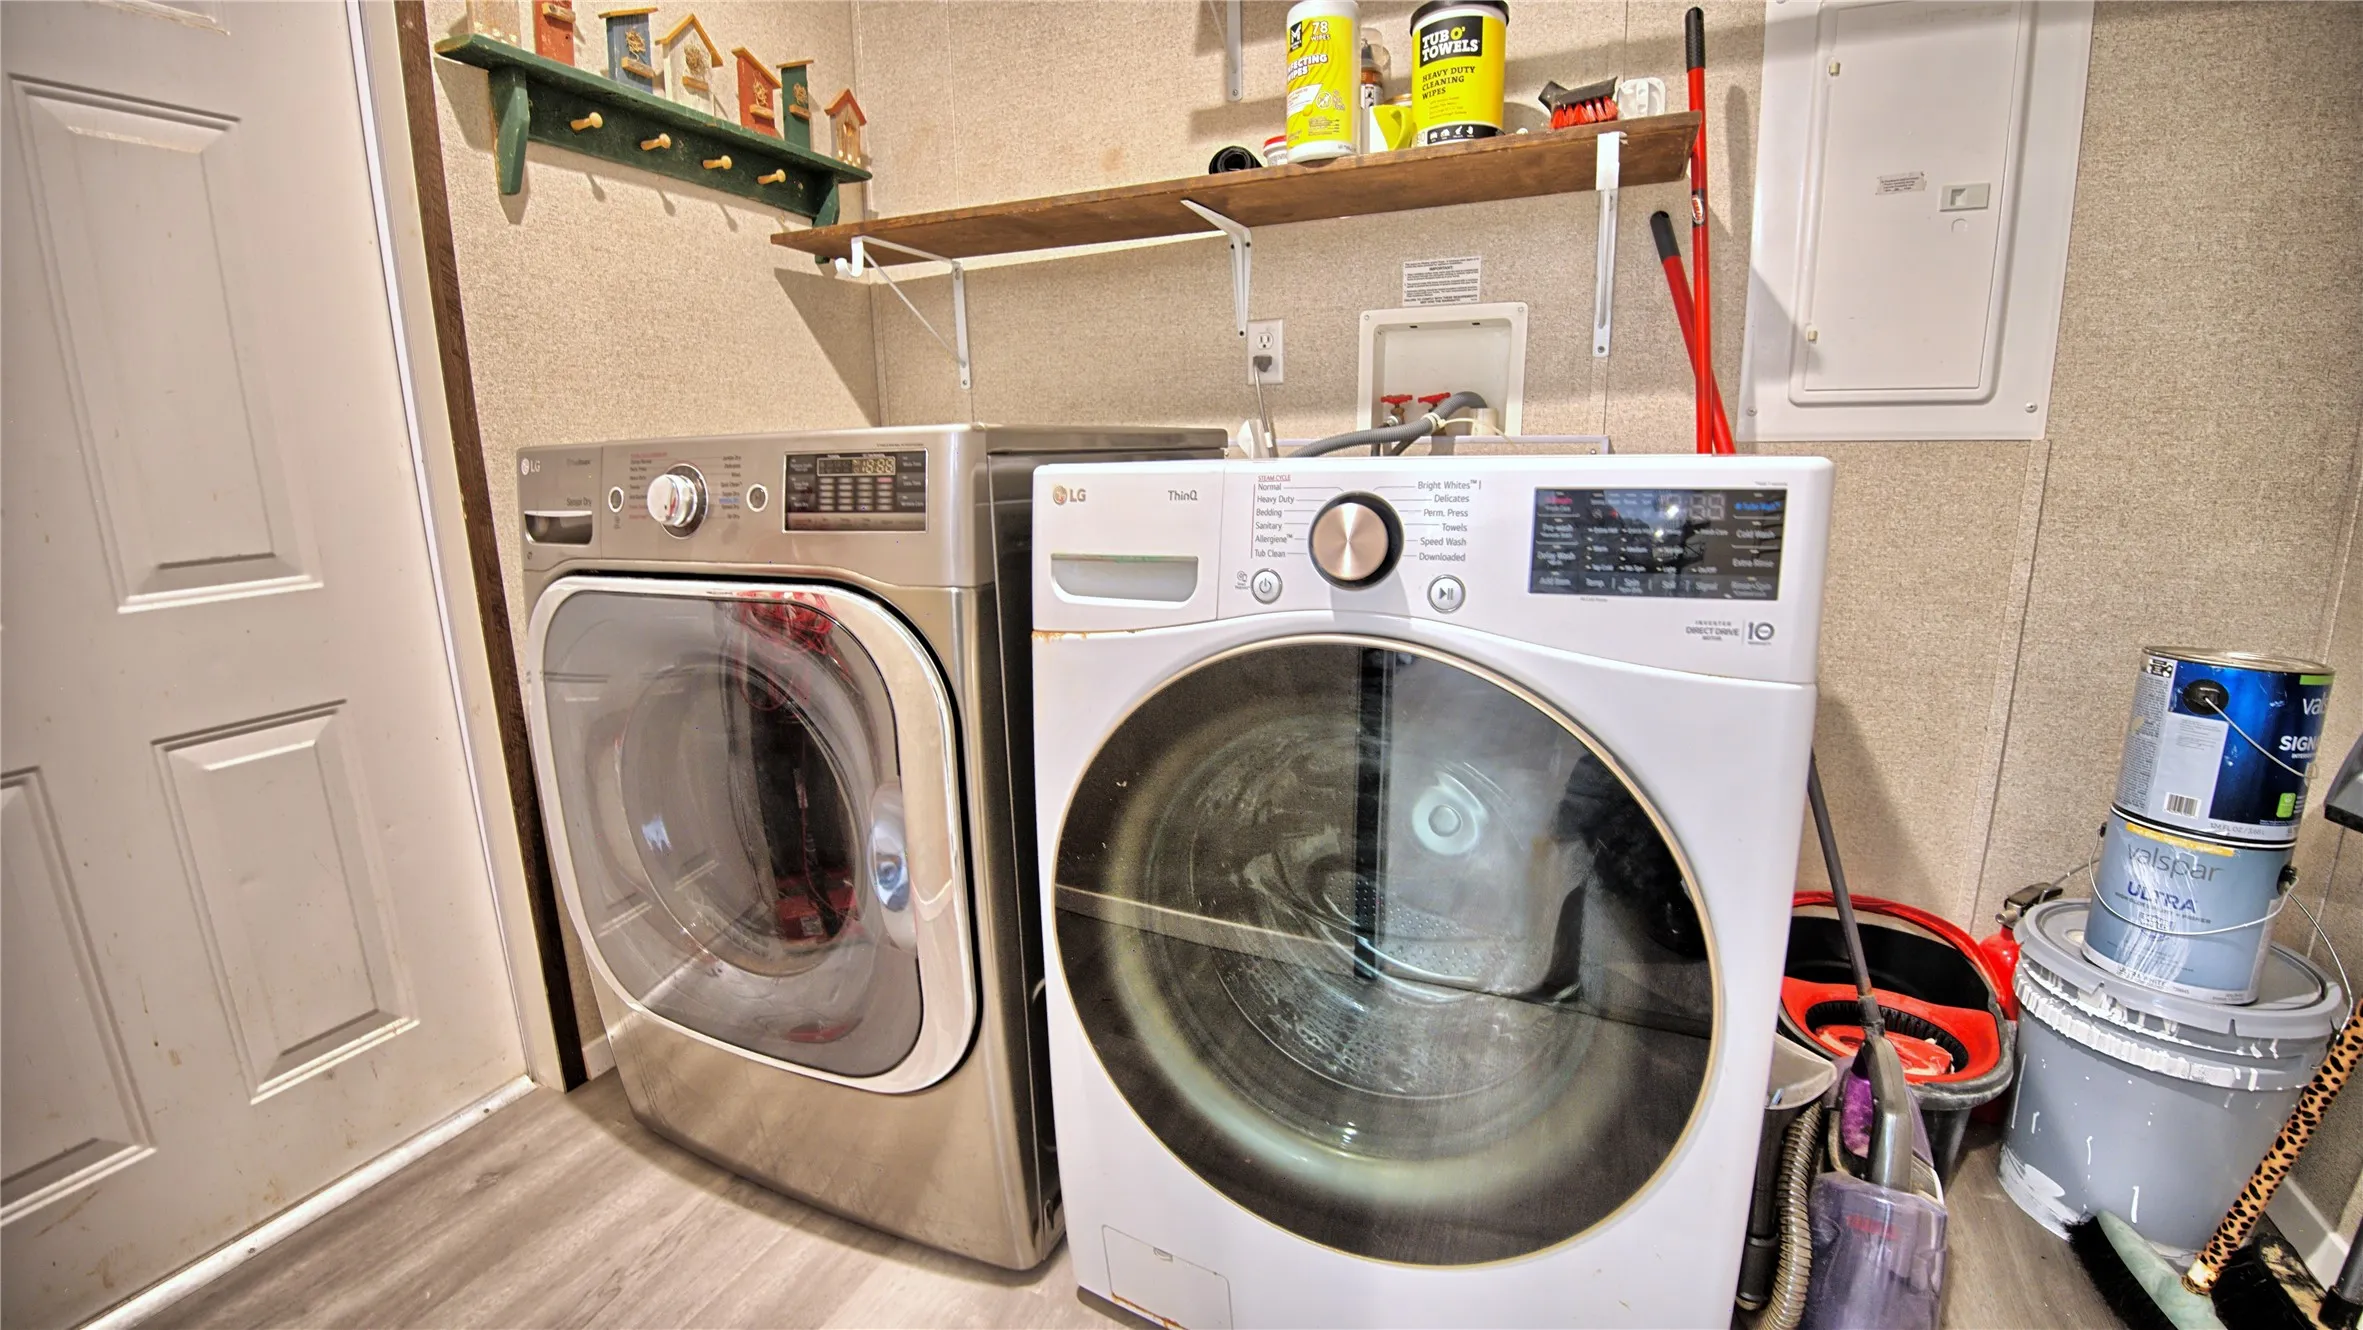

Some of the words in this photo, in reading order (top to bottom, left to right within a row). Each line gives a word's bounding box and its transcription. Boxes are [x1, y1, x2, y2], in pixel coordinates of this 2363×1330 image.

[1312, 21, 1328, 35] 78
[1422, 29, 1449, 49] TUB
[1422, 39, 1478, 62] TOWELS
[1422, 68, 1449, 83] HEAVY
[1450, 66, 1475, 76] DUTY
[1422, 75, 1465, 91] CLEANING
[1422, 87, 1446, 100] WIPES
[530, 460, 541, 472] LG
[1276, 474, 1291, 482] CYCLE
[1258, 483, 1282, 491] Normal
[1417, 481, 1441, 490] Bright
[1069, 488, 1086, 502] LG
[1168, 489, 1198, 501] ThinQ
[1257, 495, 1277, 504] Heavy
[1278, 495, 1294, 504] Duty
[1434, 494, 1470, 503] Delicates
[1256, 508, 1282, 518] Bedding
[1423, 508, 1445, 517] Perm.
[1448, 508, 1468, 517] Press
[1255, 521, 1282, 531] Sanitary
[1442, 522, 1468, 532] Towels
[1420, 537, 1443, 547] Speed
[1446, 537, 1467, 546] Wash
[1269, 550, 1286, 558] Clean
[1419, 553, 1466, 562] Downloaded
[1686, 626, 1713, 635] DIRECT
[1715, 628, 1740, 636] DRIVE
[2128, 843, 2224, 882] valspar
[2128, 881, 2196, 914] ULTRA
